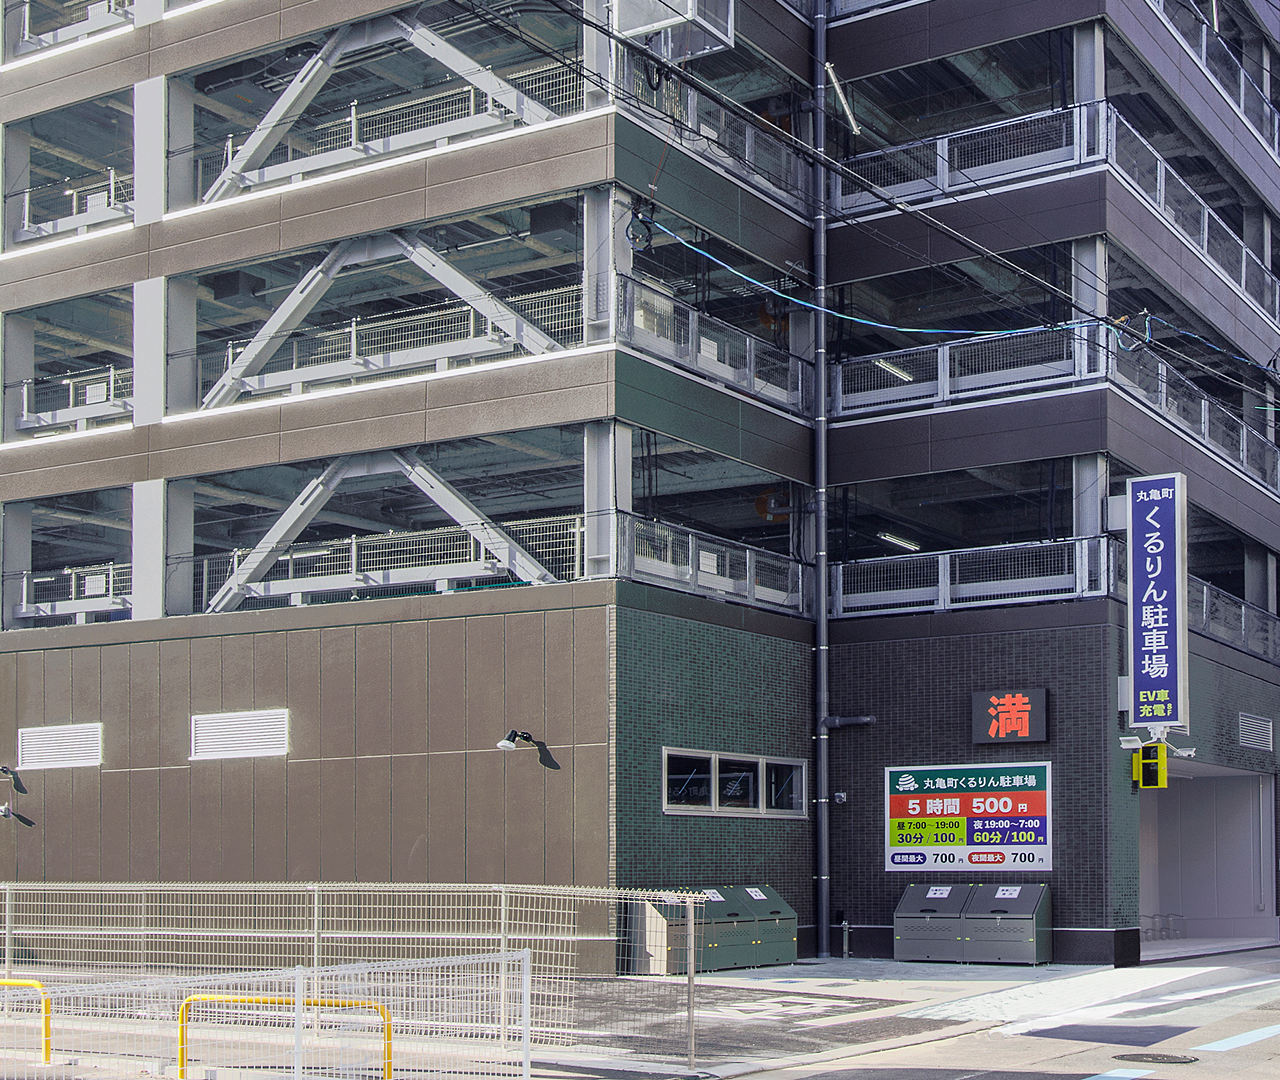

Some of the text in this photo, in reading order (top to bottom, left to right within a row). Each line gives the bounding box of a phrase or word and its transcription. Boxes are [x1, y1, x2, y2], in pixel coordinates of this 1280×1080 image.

[1136, 487, 1174, 502] 丸亀町
[1141, 506, 1169, 679] くるりん駐車場
[1140, 689, 1169, 702] EV車
[988, 694, 1031, 738] 満
[1139, 704, 1166, 717] 充電
[923, 775, 1036, 790] 丸亀町くるりん駐車場
[908, 797, 1028, 815] 5 時間 500 円
[897, 821, 905, 830] 昼
[973, 820, 983, 829] 夜
[897, 833, 924, 844] 30分
[933, 833, 955, 843] 100
[973, 831, 1002, 843] 60分
[1011, 831, 1035, 842] 100
[894, 854, 924, 863] 昼間最大
[932, 853, 955, 863] 700
[971, 854, 1003, 862] 夜間最大
[1011, 852, 1035, 862] 700
